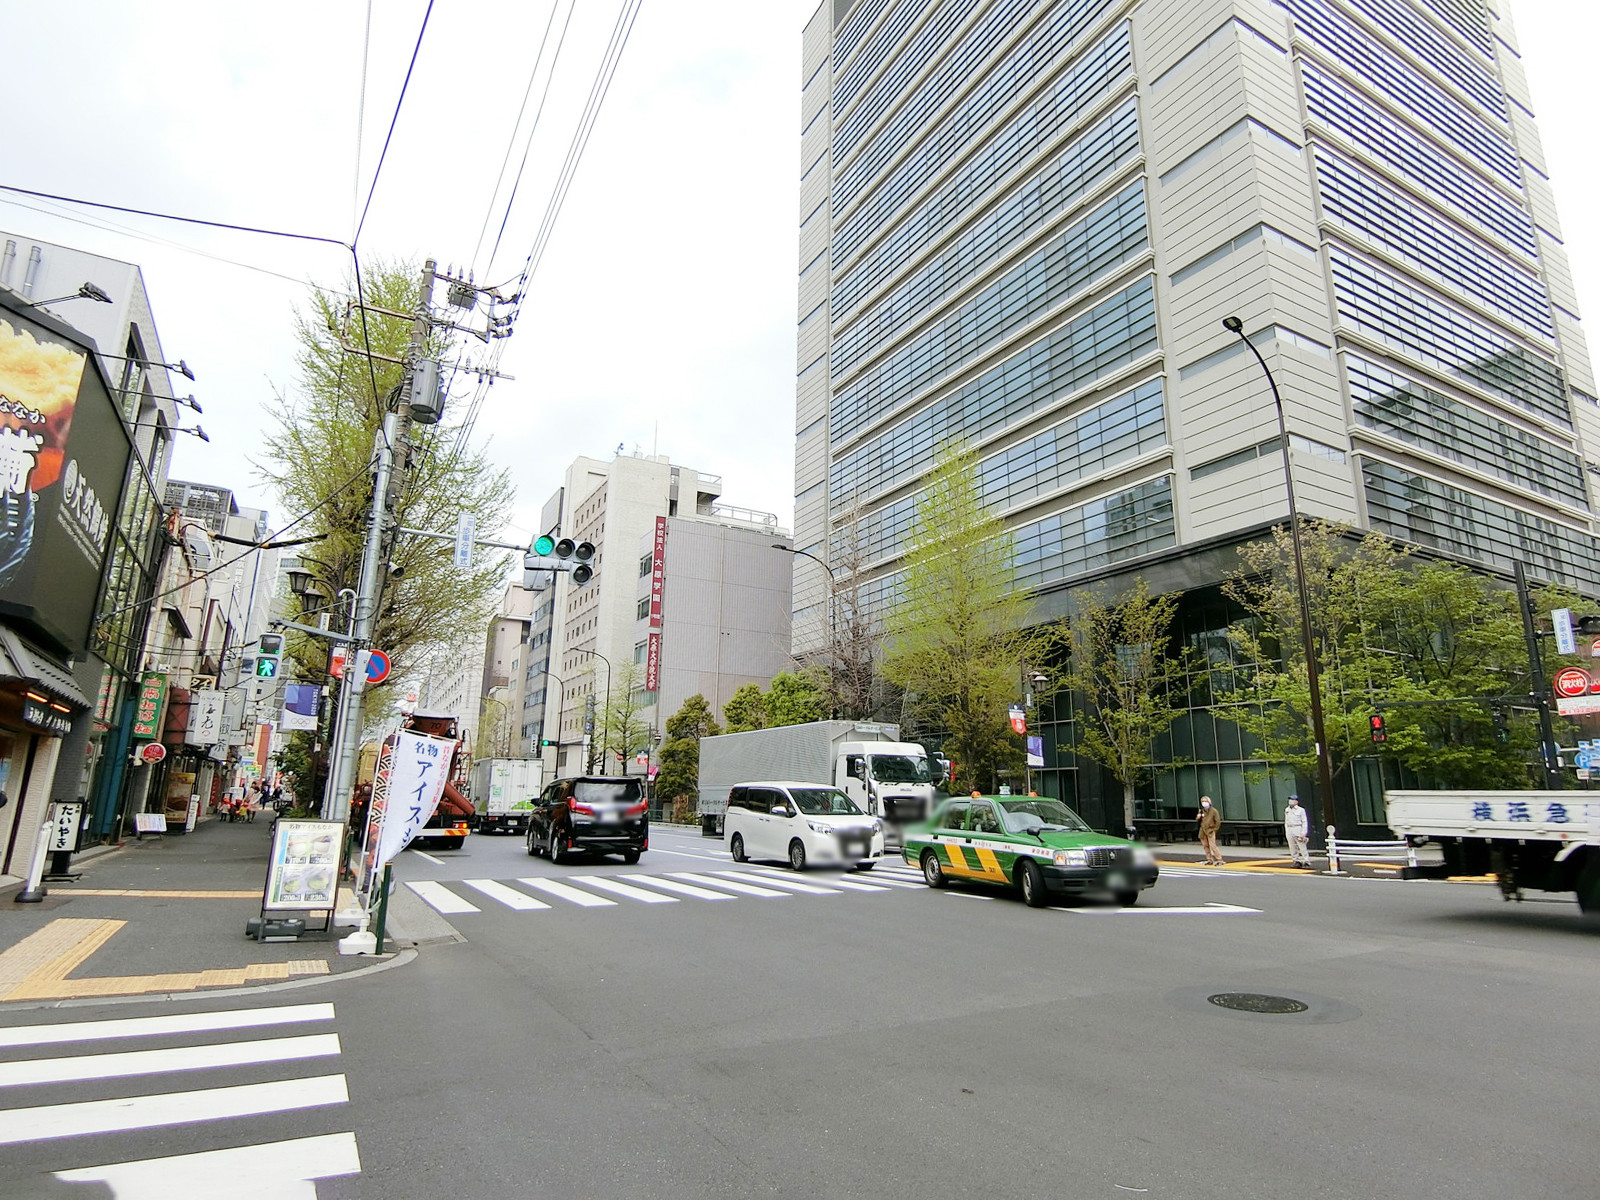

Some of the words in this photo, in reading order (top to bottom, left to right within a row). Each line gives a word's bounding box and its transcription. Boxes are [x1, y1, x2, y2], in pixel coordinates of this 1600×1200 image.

[652, 559, 663, 603] 大原学園
[1562, 678, 1585, 689] 消火栓
[415, 741, 439, 757] 名物
[56, 804, 74, 848] たいやき
